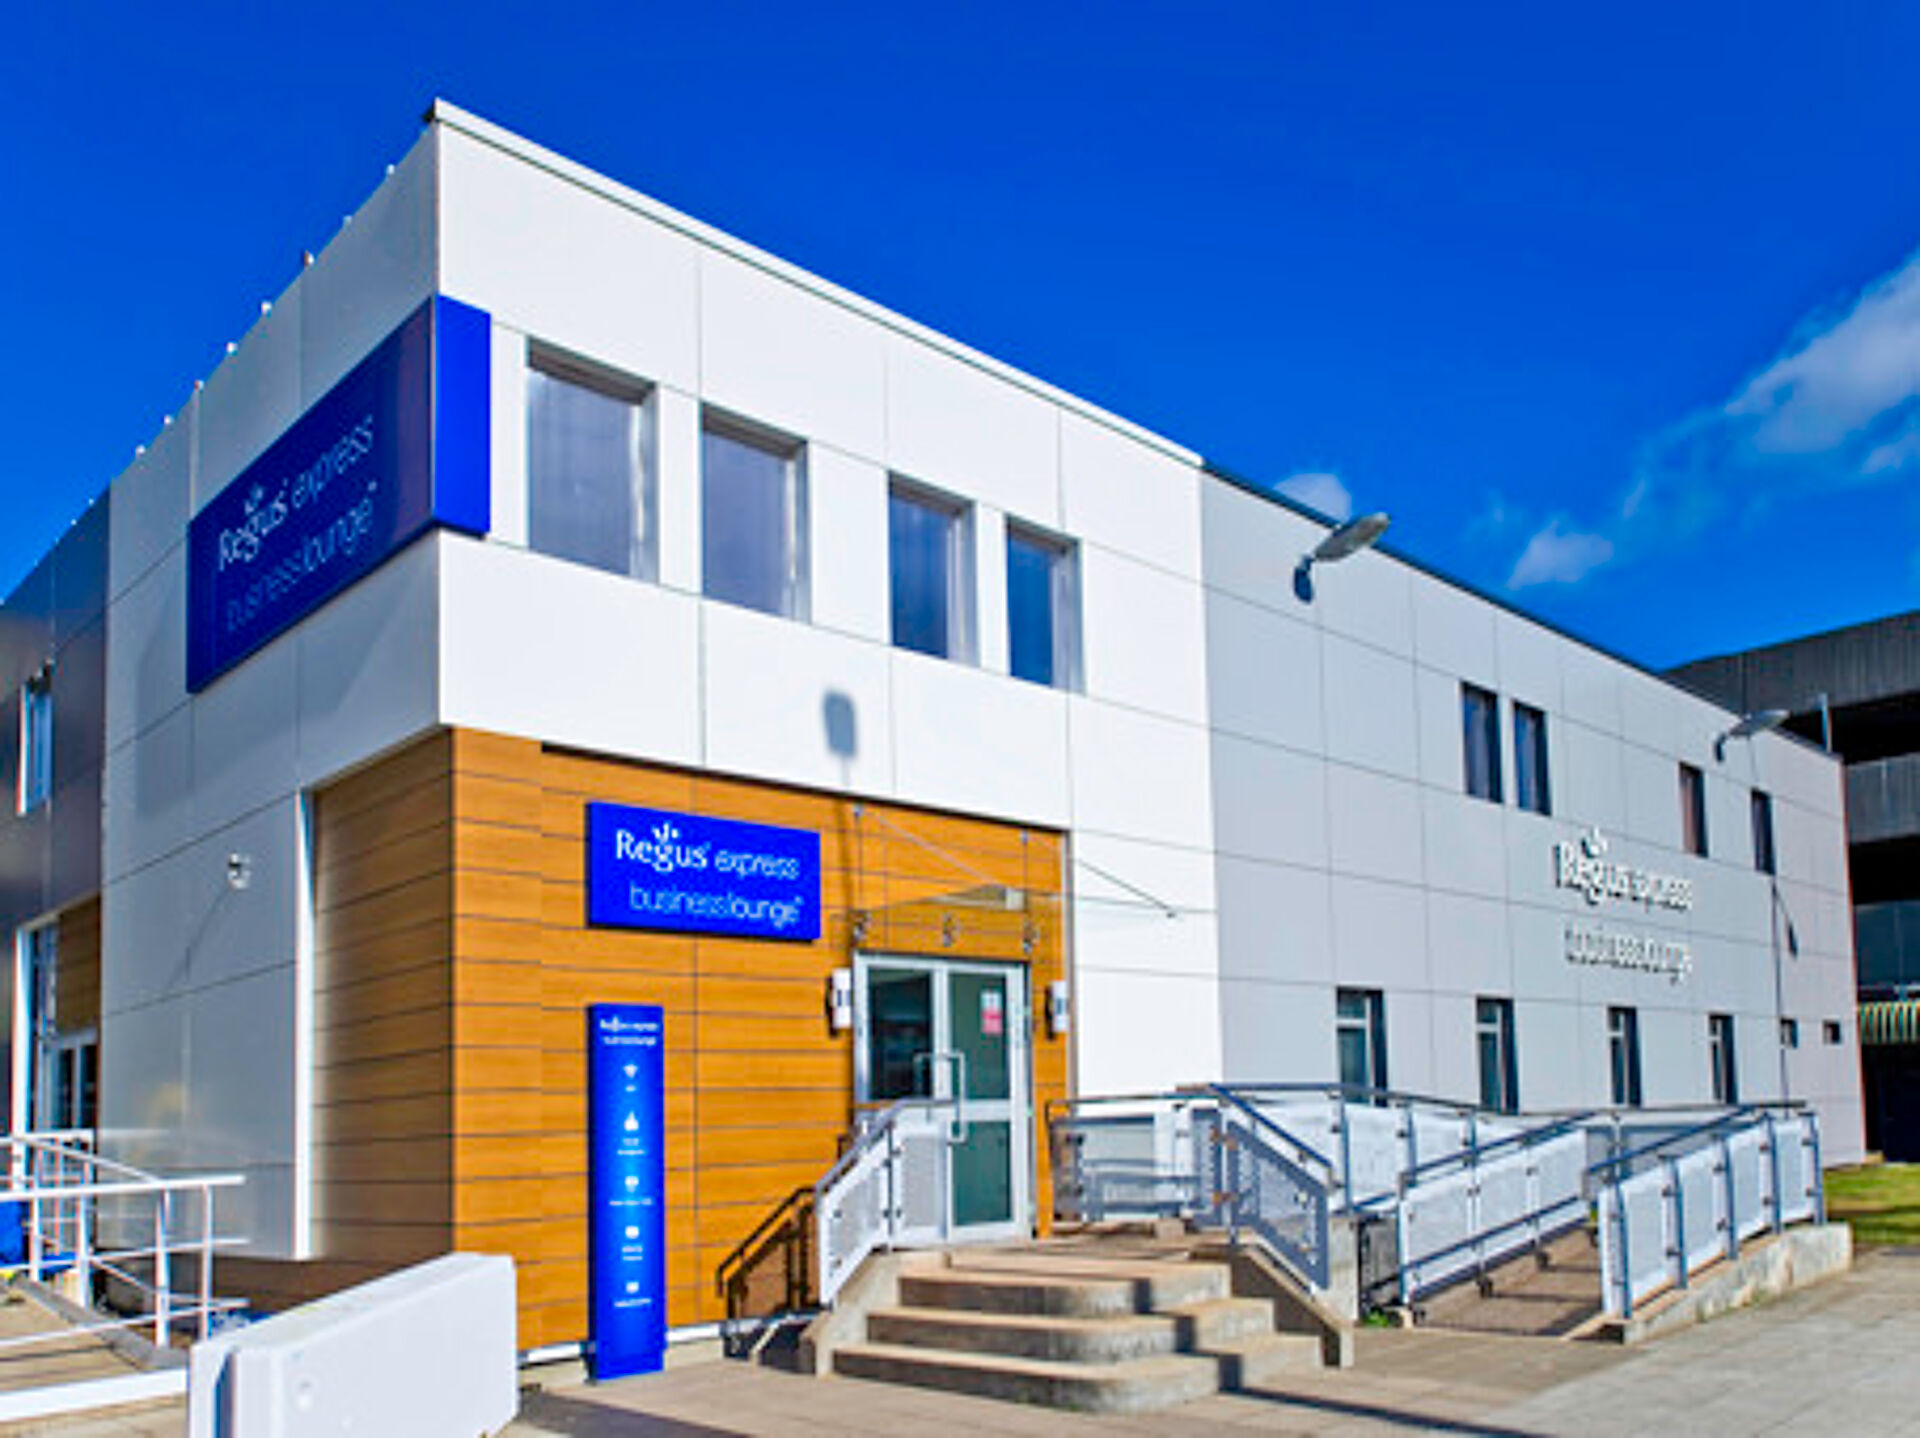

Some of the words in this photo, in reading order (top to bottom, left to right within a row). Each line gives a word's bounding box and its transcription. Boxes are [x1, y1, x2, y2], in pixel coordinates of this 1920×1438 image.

[218, 500, 289, 572] Regus
[291, 416, 374, 508] express
[615, 826, 708, 872] Regus
[714, 850, 799, 880] express
